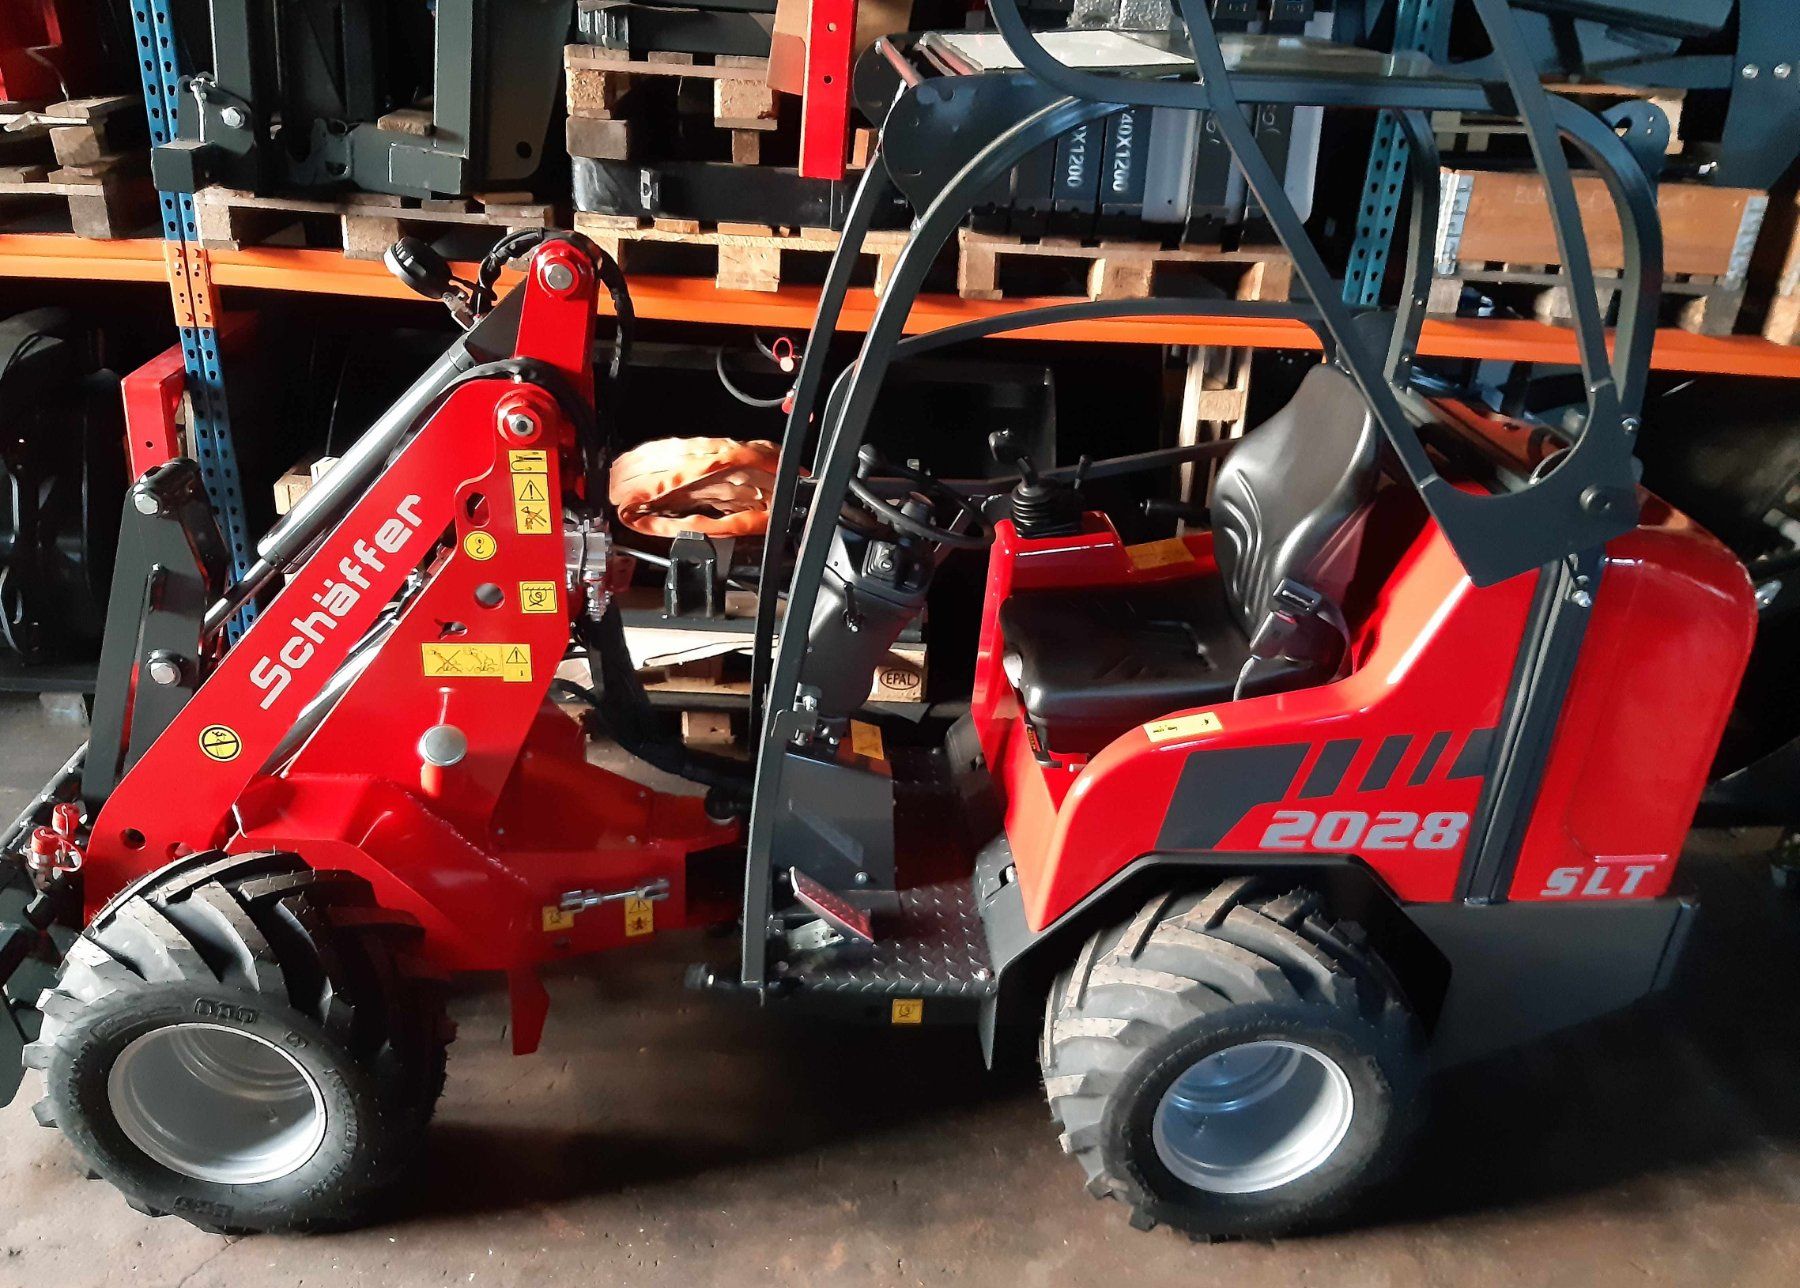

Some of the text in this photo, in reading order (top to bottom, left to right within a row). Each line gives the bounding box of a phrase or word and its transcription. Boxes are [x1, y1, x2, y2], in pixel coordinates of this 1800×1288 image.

[250, 494, 422, 710] Schäffer
[886, 672, 913, 685] EPAL
[1259, 811, 1469, 849] 2028
[1540, 865, 1655, 896] SLT
